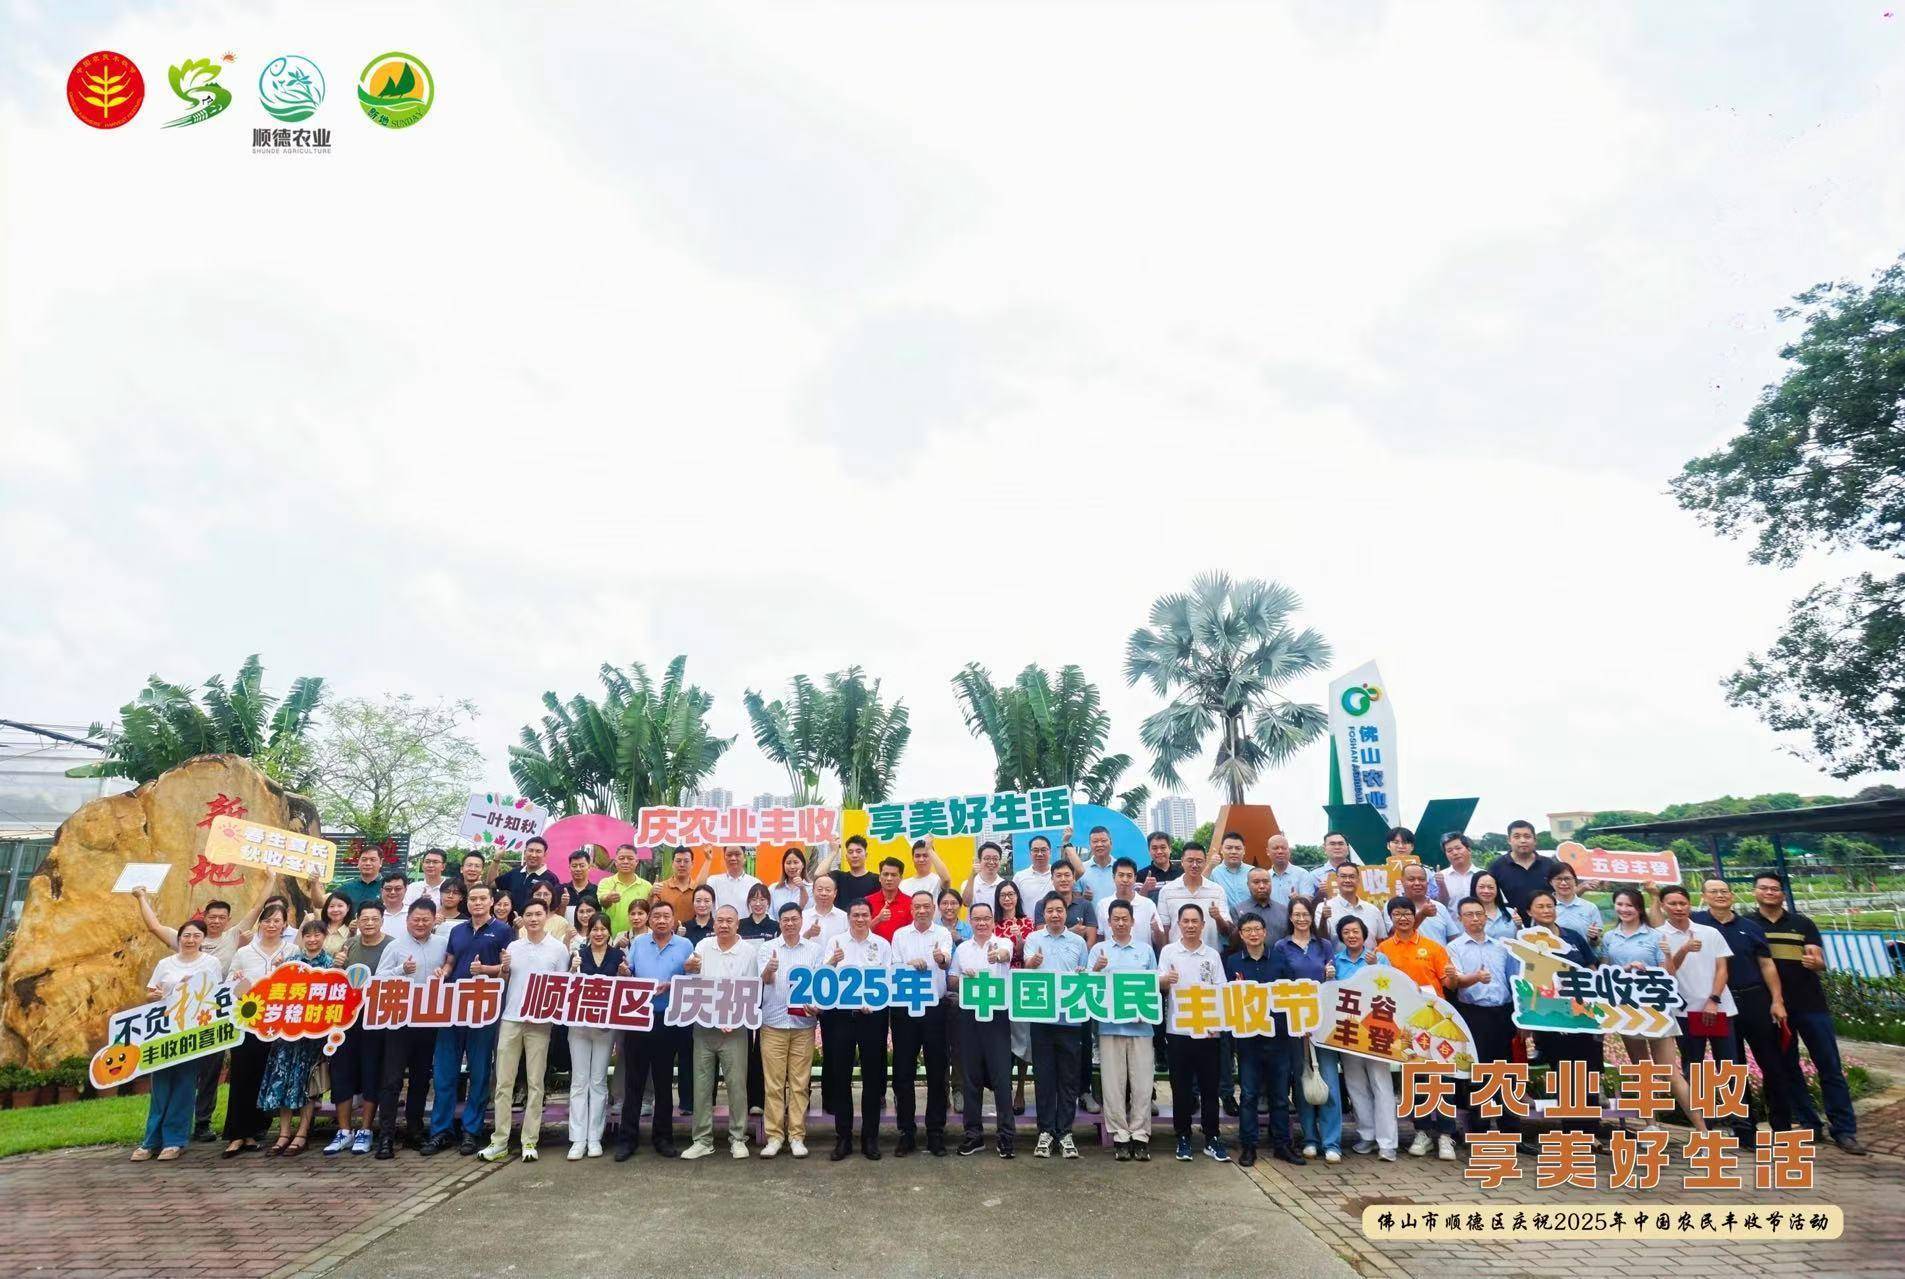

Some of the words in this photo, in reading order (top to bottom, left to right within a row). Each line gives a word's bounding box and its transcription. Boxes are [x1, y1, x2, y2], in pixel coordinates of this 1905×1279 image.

[1360, 725, 1389, 822] 佛山农业
[471, 811, 537, 835] 一叶知秋
[638, 808, 836, 844] 庆农业丰收
[868, 788, 1071, 841] 享美好生活
[1591, 857, 1671, 876] 五谷丰登
[366, 977, 501, 1026] 佛山市
[520, 972, 656, 1028] 顺德区
[667, 977, 760, 1026] 庆祝
[788, 968, 934, 1012] 2025年
[963, 971, 1162, 1020] 中国农民
[1175, 982, 1321, 1034] 丰收节
[1335, 987, 1397, 1023] 五谷
[1556, 966, 1679, 1012] 丰收季
[142, 1022, 235, 1065] 丰收的喜悦
[1333, 1018, 1396, 1056] 丰登
